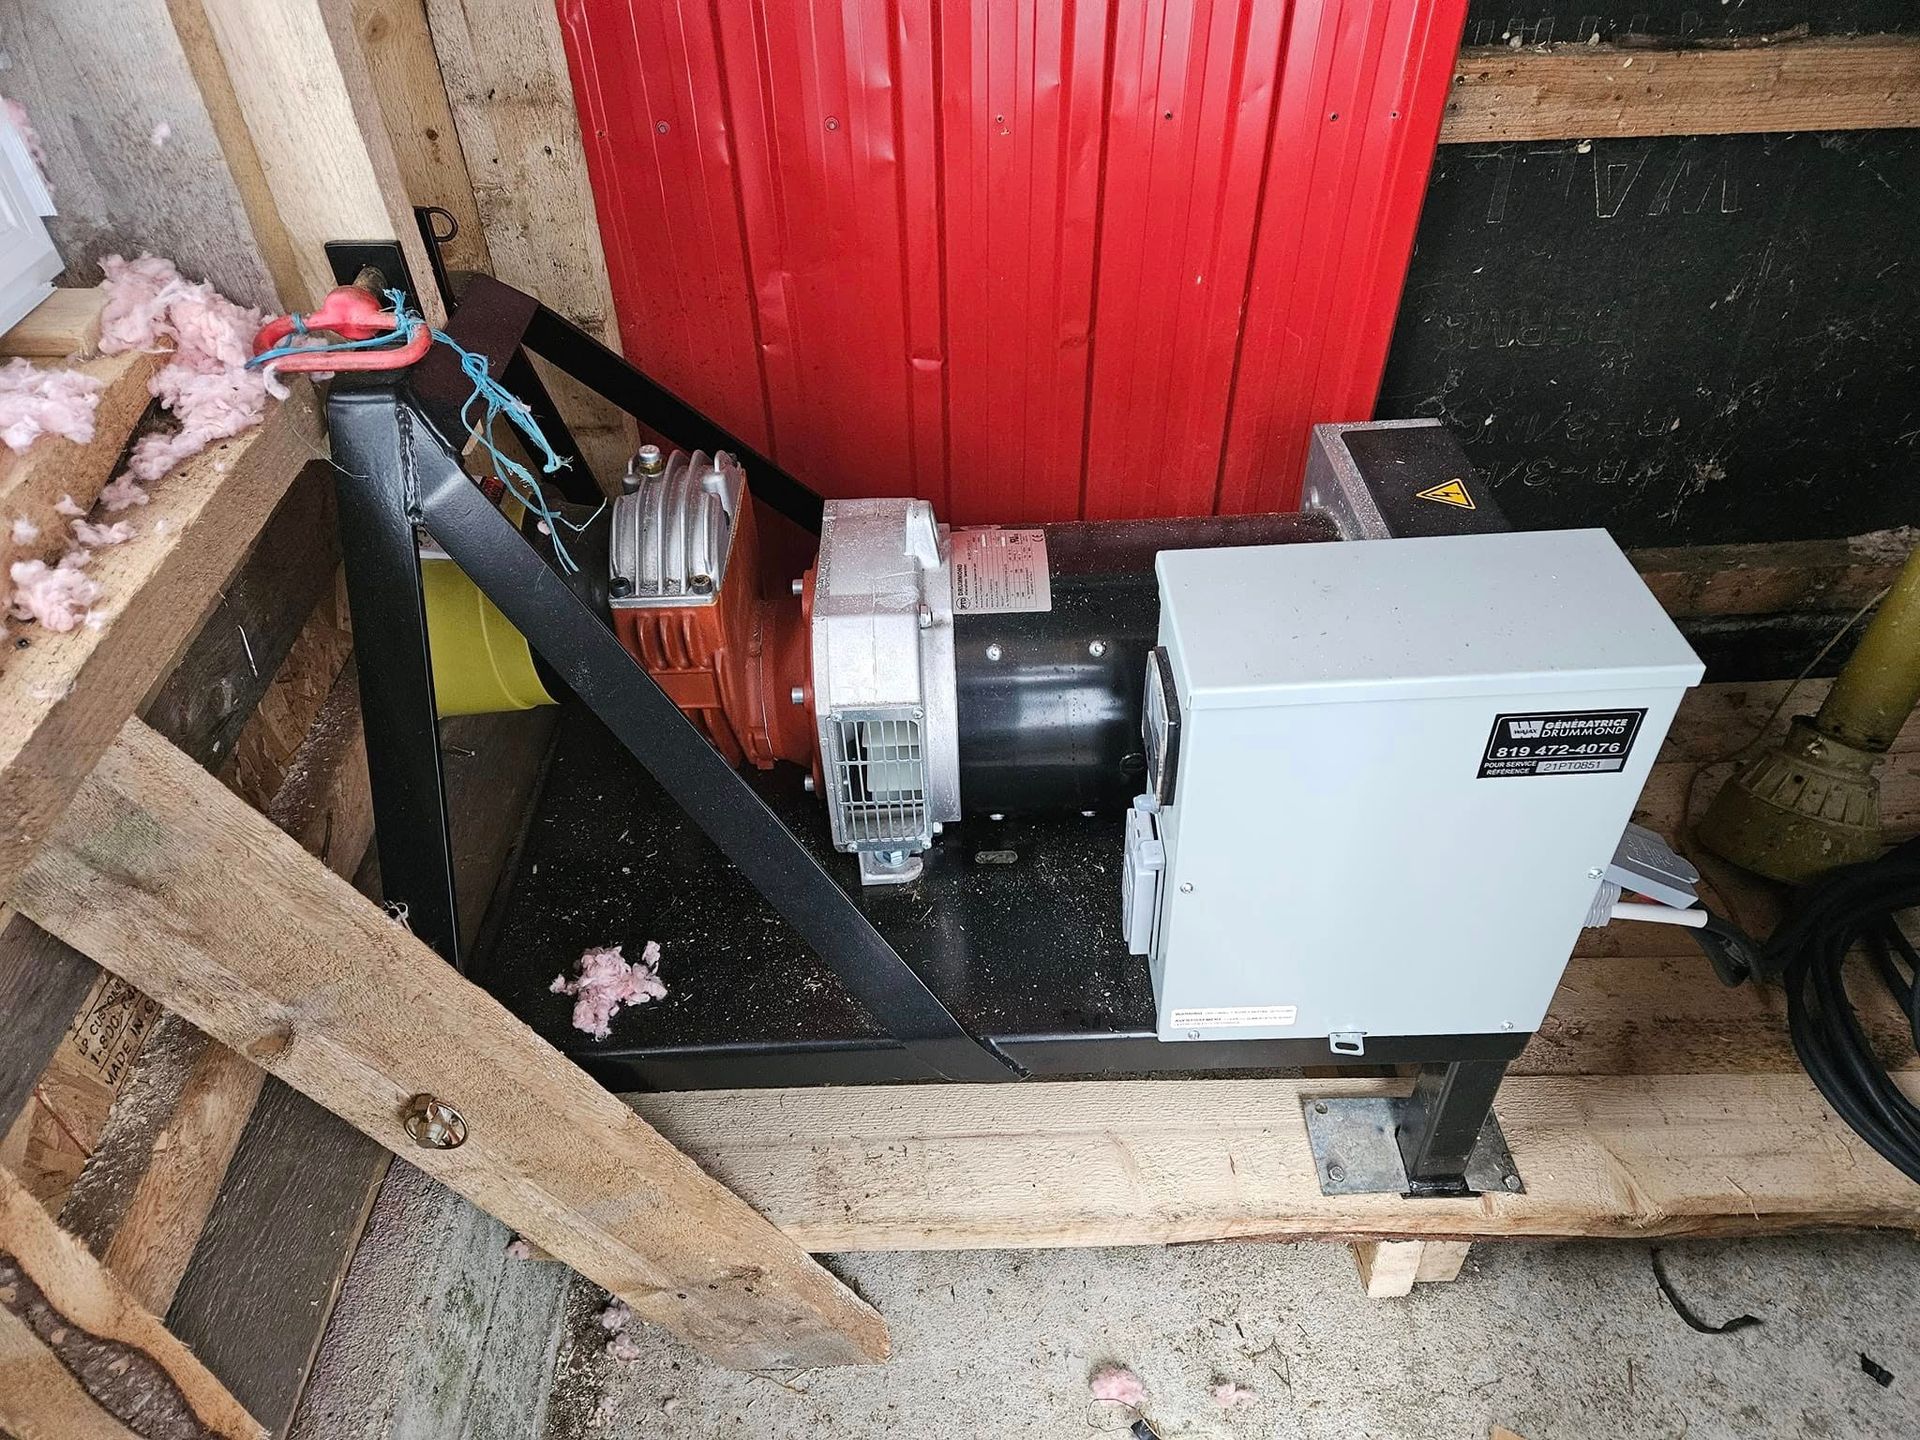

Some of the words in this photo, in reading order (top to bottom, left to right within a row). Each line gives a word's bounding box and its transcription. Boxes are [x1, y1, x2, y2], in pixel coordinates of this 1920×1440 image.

[1544, 718, 1629, 730] GÉNÉRATRICE
[1541, 726, 1625, 738] DRUMMOND
[1496, 746, 1531, 757] 819
[1535, 742, 1621, 756] 472-4076
[1484, 761, 1505, 769] POUR
[1506, 760, 1537, 768] SERVICE
[1543, 761, 1601, 772] 21PT0851
[1486, 767, 1531, 776] RÉFÉRENCE
[79, 1038, 89, 1056] LP
[105, 1040, 132, 1086] MADE
[130, 1018, 145, 1039] IN
